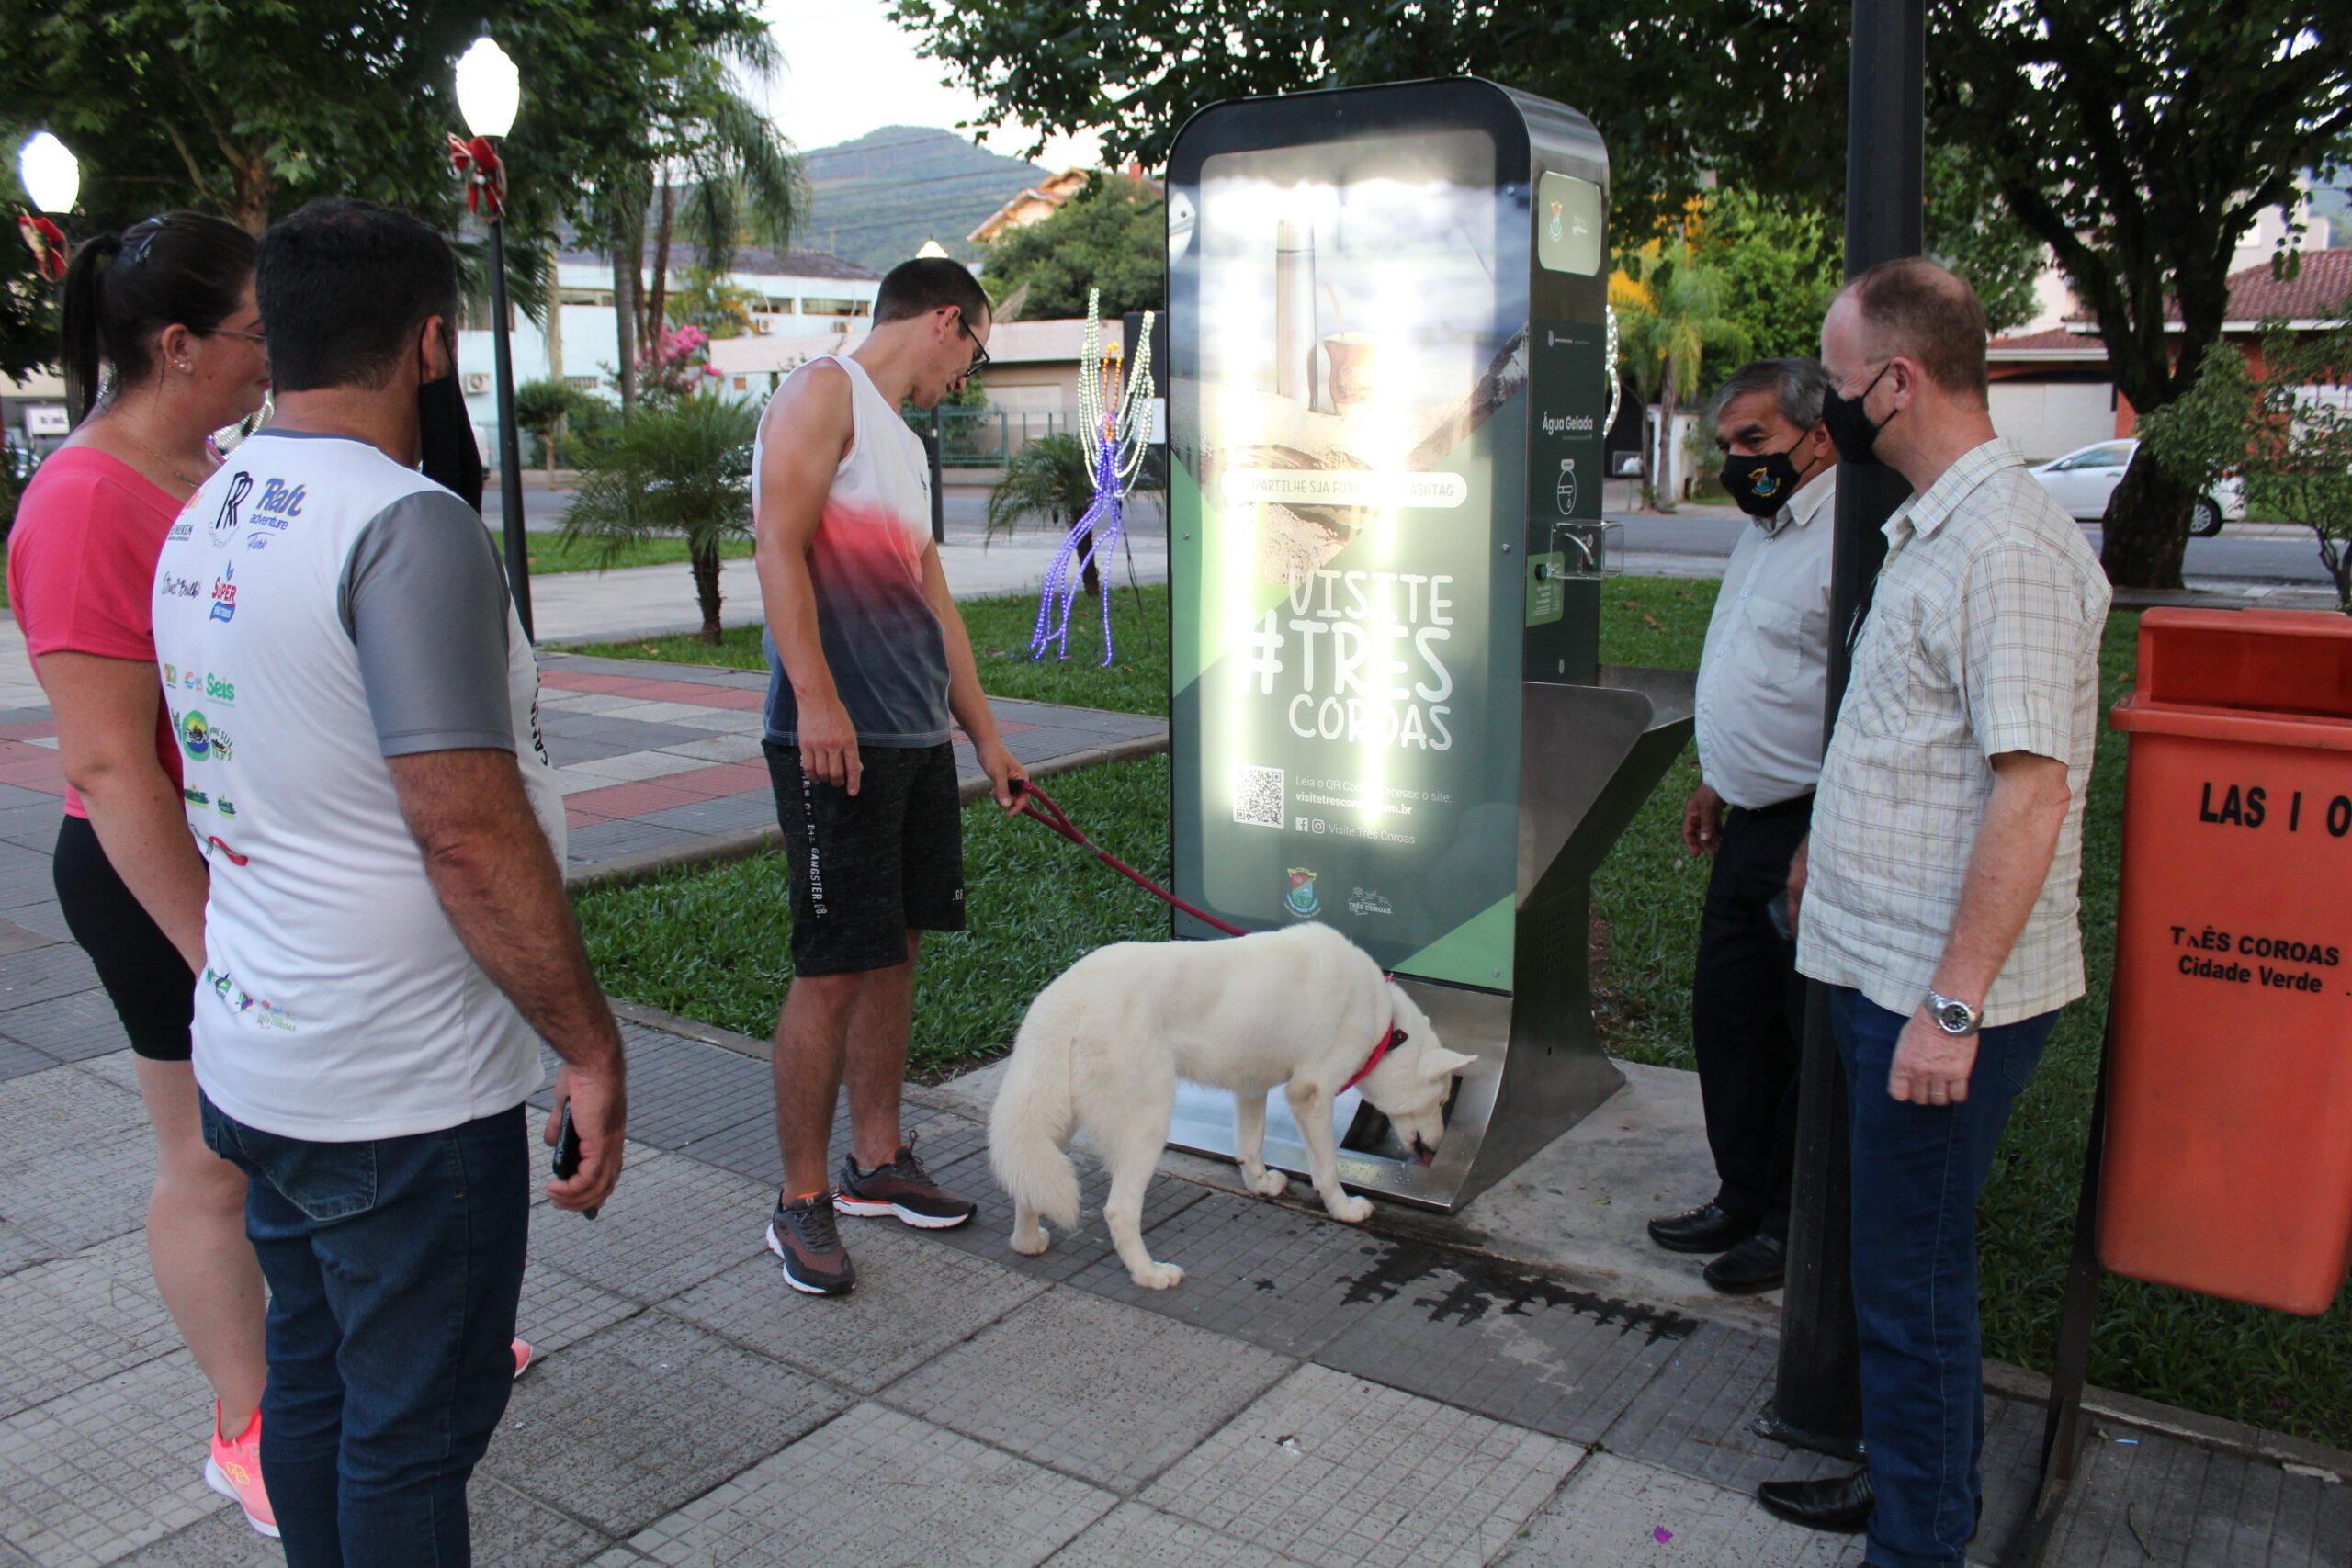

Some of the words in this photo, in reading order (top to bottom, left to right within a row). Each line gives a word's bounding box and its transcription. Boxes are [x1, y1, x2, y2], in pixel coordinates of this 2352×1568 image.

[1543, 412, 1564, 435] Água
[1566, 415, 1593, 431] Gelada
[256, 478, 306, 517] Raft
[1310, 480, 1329, 493] SUA
[249, 513, 288, 531] adventure
[1288, 568, 1453, 626] VISITE
[207, 672, 235, 702] Seis
[1288, 694, 1453, 751] COROAS
[1295, 775, 1315, 787] Leia
[1317, 779, 1324, 787] o
[1326, 779, 1340, 791] QR
[1342, 781, 1368, 794] Cod
[1421, 791, 1429, 801] o
[1431, 792, 1453, 803] site:
[2199, 782, 2266, 828] LAS
[1329, 823, 1355, 837] Visite
[1357, 827, 1378, 840] Três
[1380, 829, 1416, 845] Coroas
[2238, 936, 2340, 967] COROAS
[2178, 954, 2251, 984] Cidade
[2258, 964, 2323, 994] Verde
